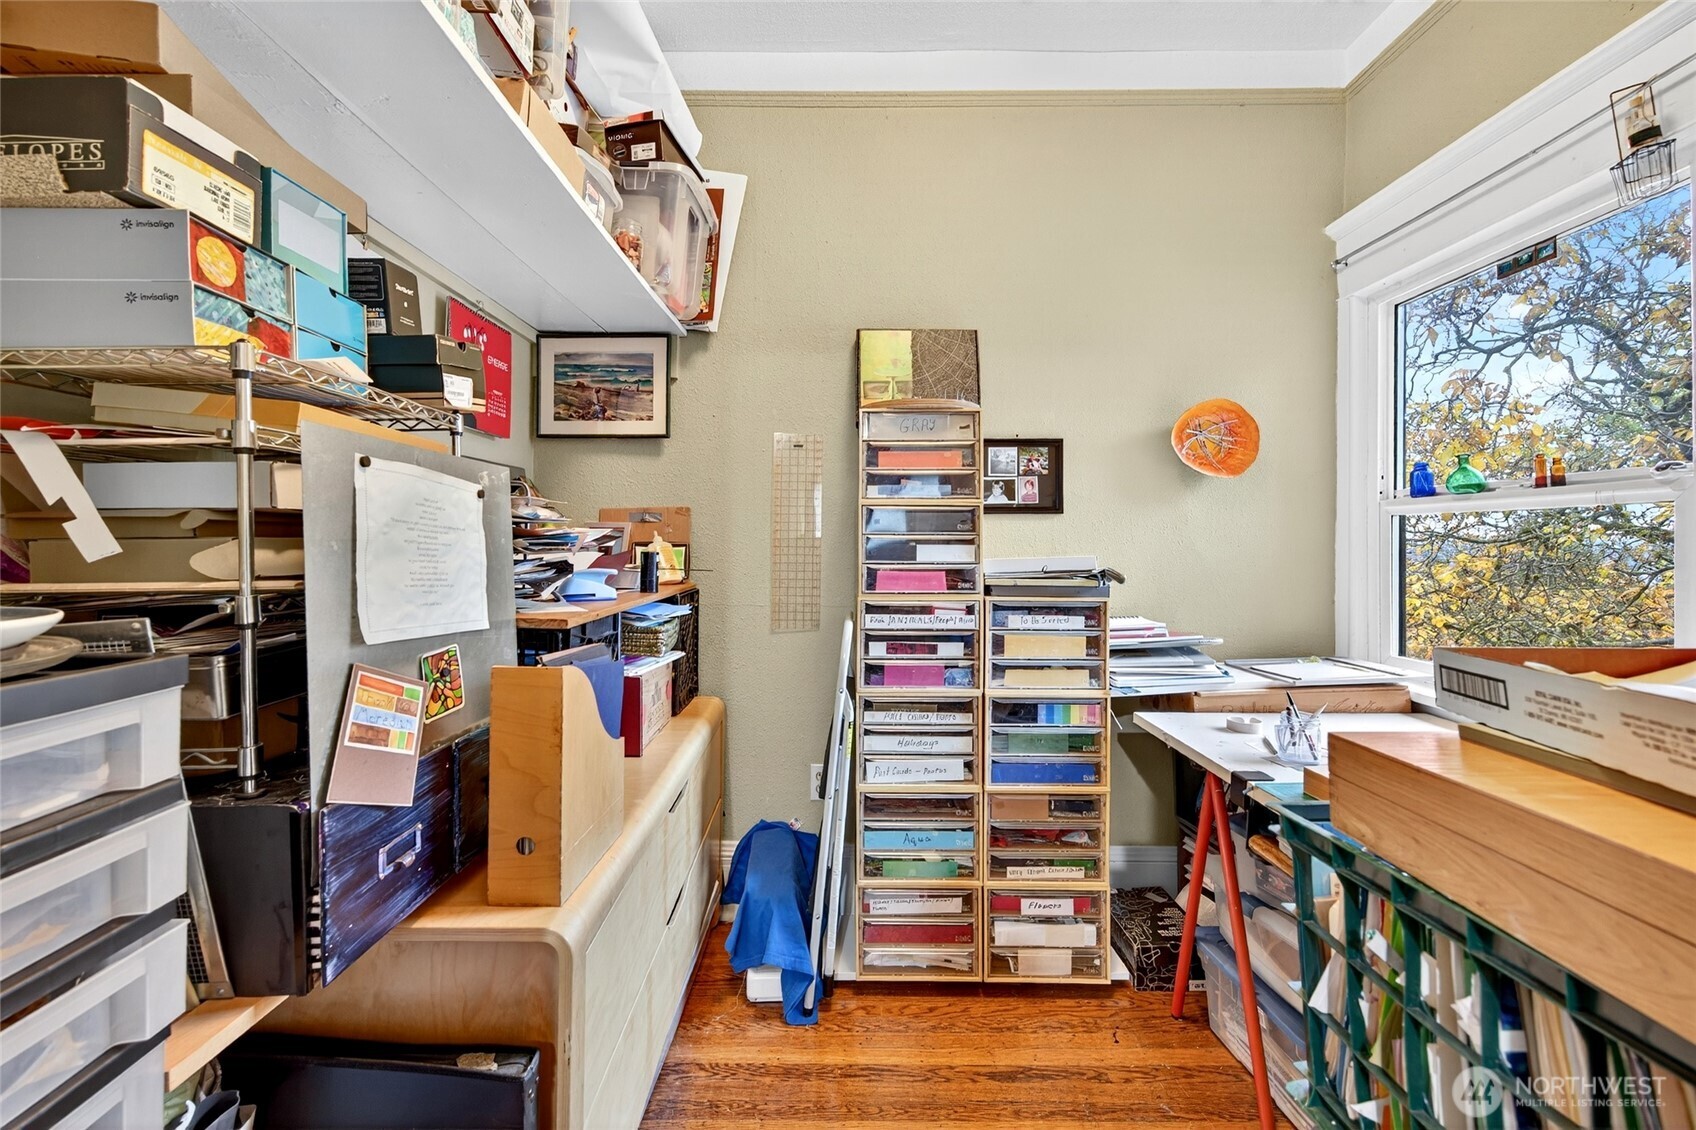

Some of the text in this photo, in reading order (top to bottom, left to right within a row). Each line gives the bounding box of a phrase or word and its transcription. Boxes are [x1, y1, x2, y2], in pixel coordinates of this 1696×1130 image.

[136, 220, 175, 229] invisalign
[140, 293, 179, 302] invisalign
[900, 418, 936, 433] GRAY
[903, 832, 931, 846] Aqua
[1028, 901, 1062, 910] Flowers
